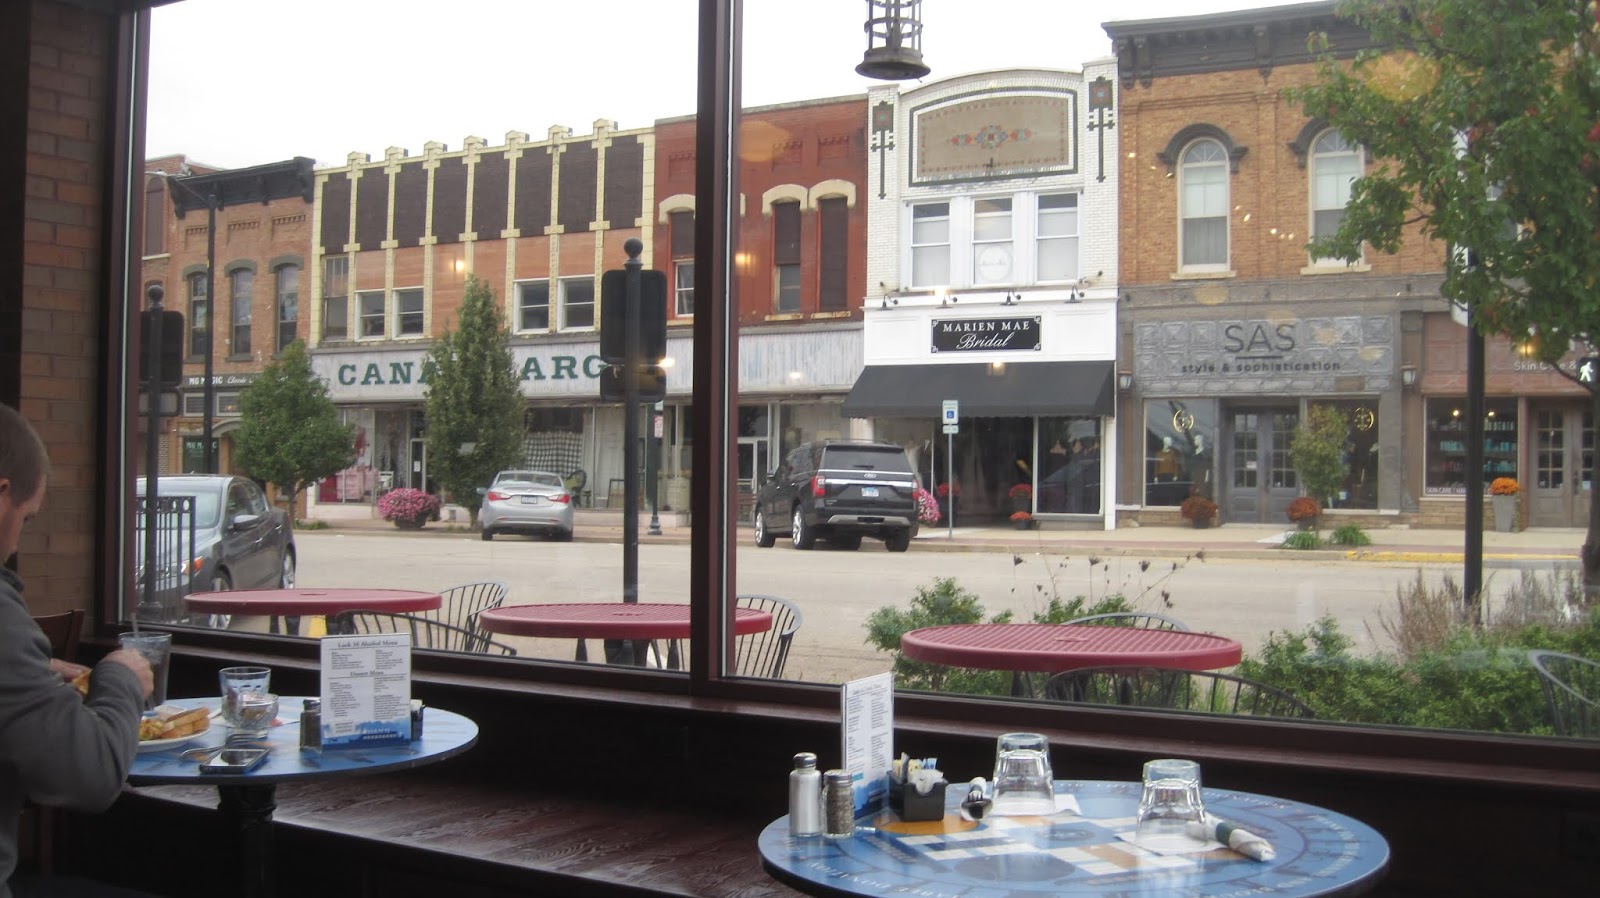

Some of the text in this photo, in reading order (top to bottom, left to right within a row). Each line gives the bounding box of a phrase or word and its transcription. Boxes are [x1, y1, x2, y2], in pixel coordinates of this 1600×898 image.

[943, 321, 1030, 332] MARIEN MAE
[956, 331, 1015, 349] Bridal
[1224, 323, 1296, 353] SAS
[1182, 361, 1341, 374] style & sophistication
[1514, 361, 1537, 371] Skin
